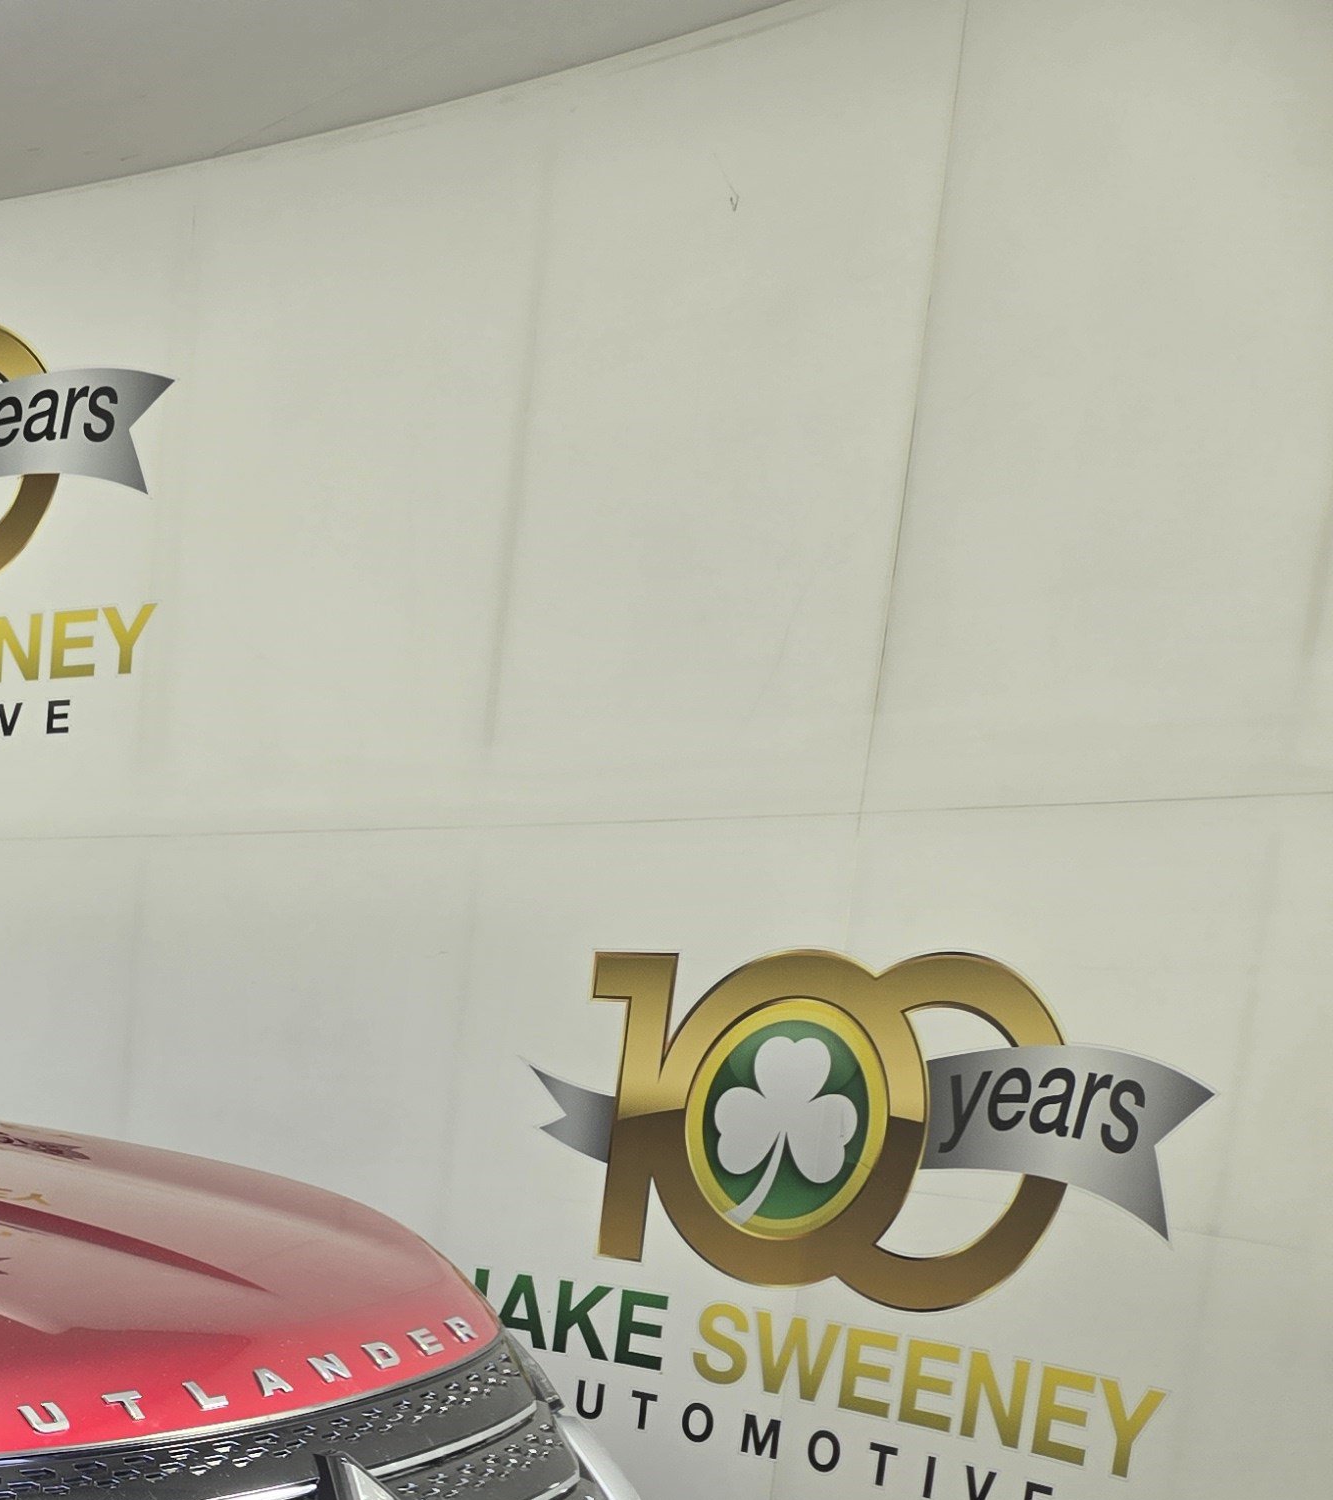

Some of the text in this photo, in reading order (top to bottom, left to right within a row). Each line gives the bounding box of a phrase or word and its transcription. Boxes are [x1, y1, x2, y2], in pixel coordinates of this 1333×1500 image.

[592, 949, 1146, 1313] 100 years
[693, 1303, 1166, 1479] SWEENEY
